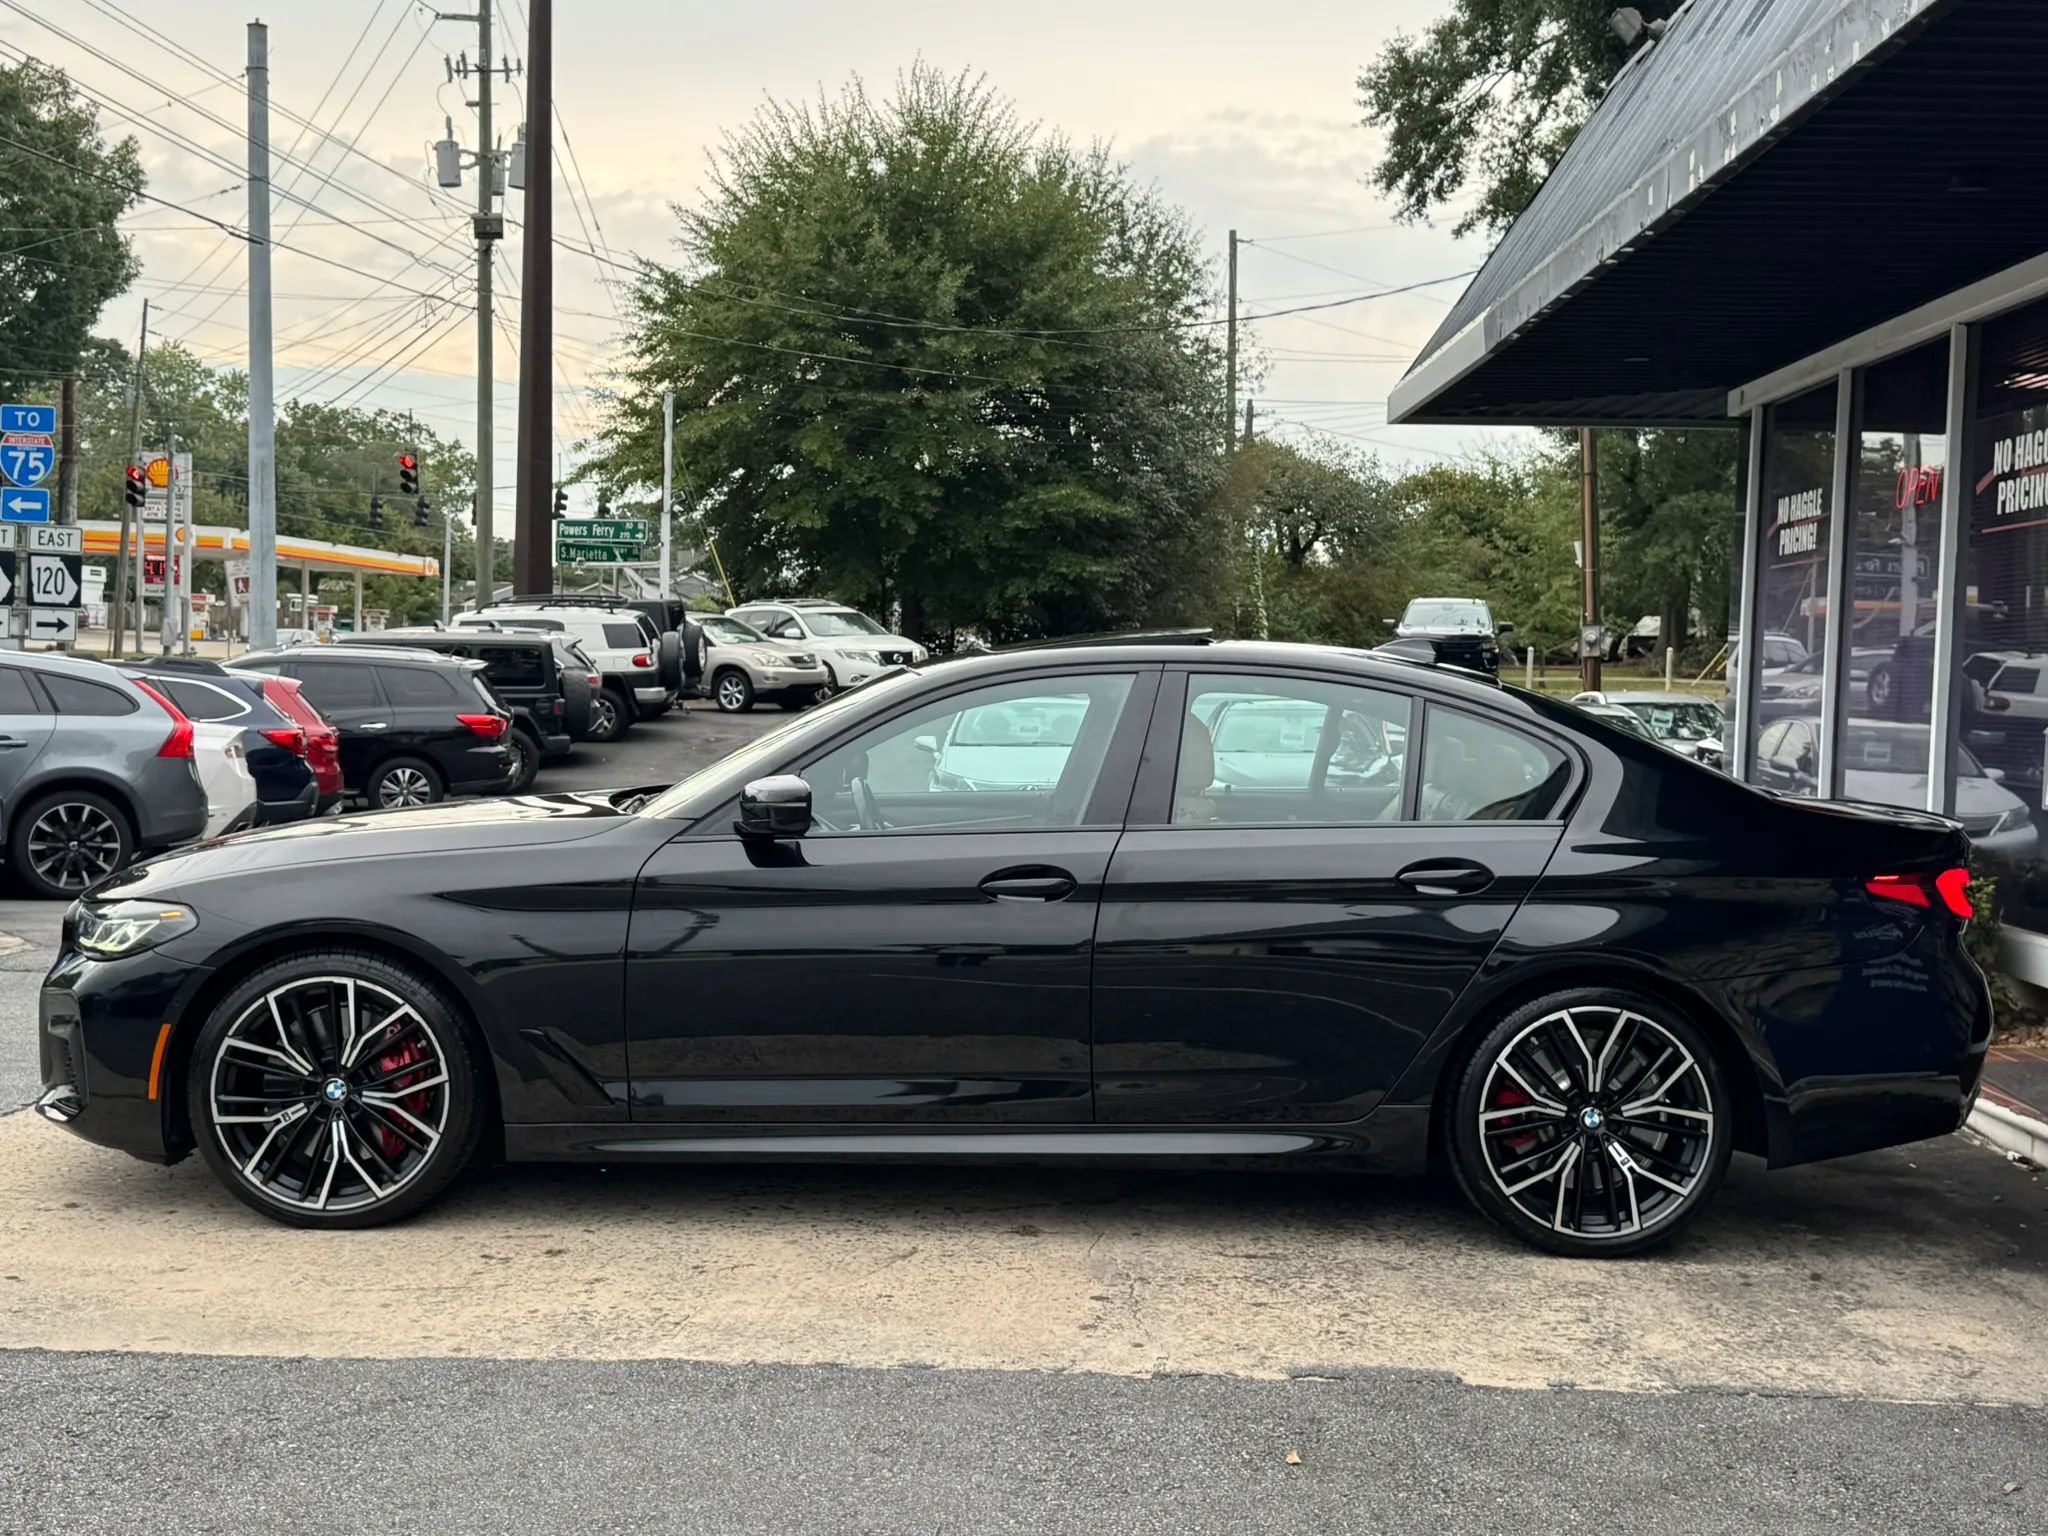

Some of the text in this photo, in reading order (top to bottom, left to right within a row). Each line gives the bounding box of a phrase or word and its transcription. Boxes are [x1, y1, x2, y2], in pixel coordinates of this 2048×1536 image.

[14, 411, 40, 427] TO
[8, 451, 45, 480] 75
[1993, 438, 2013, 476] NO
[1896, 464, 1940, 509] OPEN
[1777, 488, 1823, 525] NO HAGGLE
[37, 530, 73, 547] EAST
[559, 523, 588, 536] Powers
[592, 524, 615, 539] Ferry
[1779, 522, 1818, 556] PRICING!
[36, 566, 65, 595] 120
